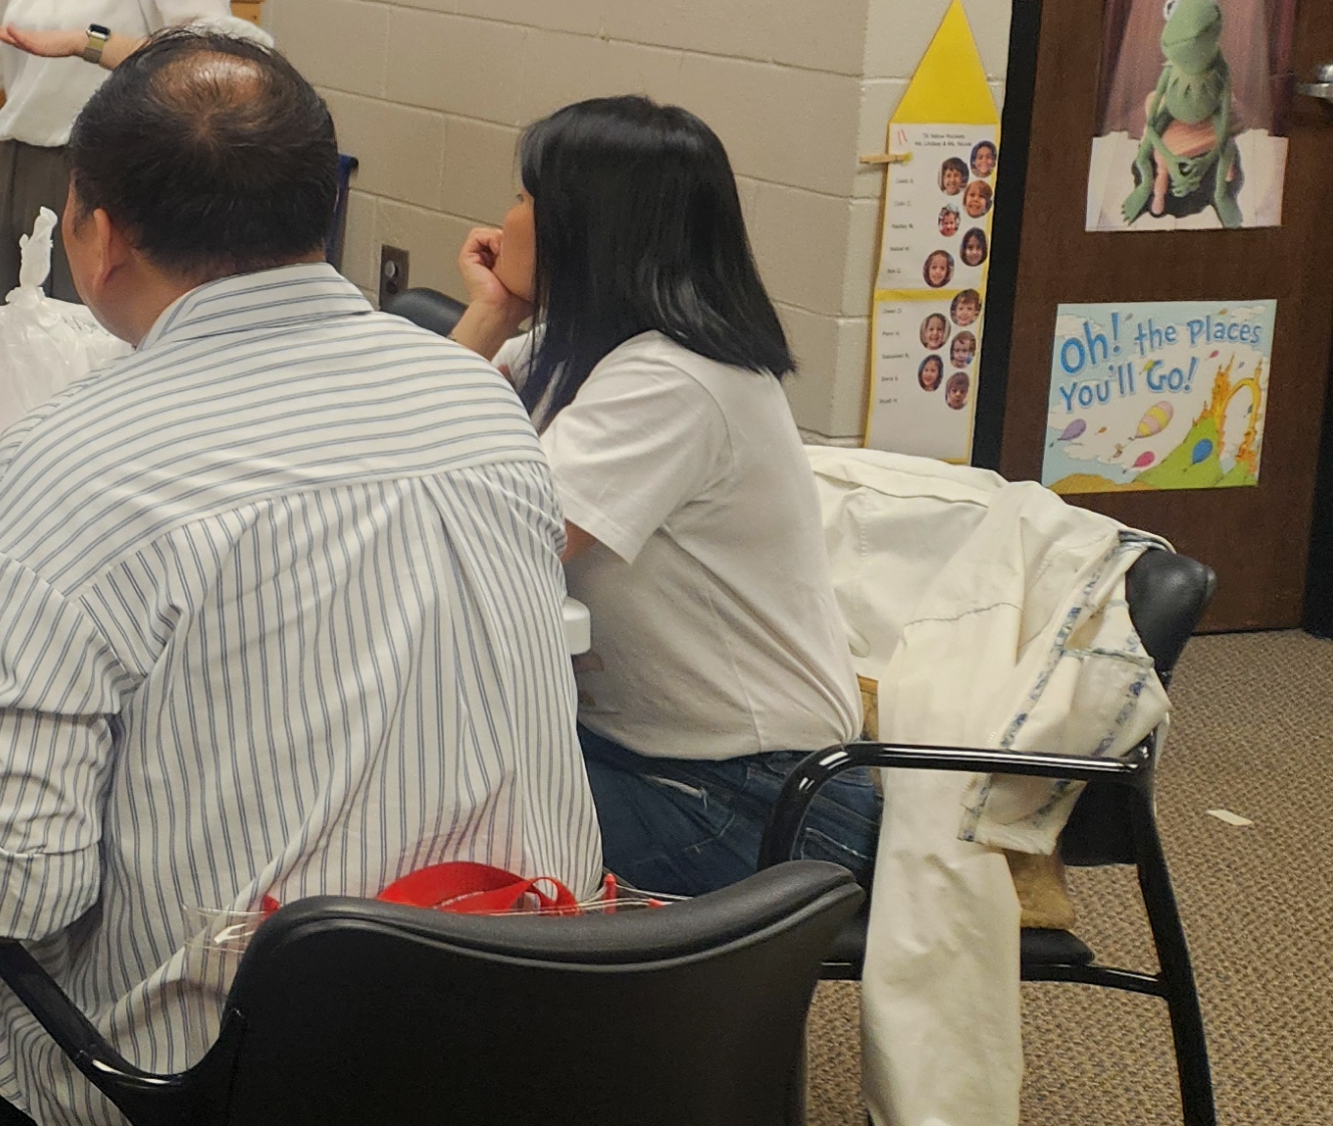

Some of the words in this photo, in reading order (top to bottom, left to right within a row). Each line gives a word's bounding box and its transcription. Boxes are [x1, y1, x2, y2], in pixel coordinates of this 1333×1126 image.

[1060, 312, 1121, 374] Oh!
[1134, 318, 1177, 356] the
[1187, 314, 1262, 345] Places
[1059, 362, 1134, 412] You'll
[1147, 356, 1199, 393] Go!
